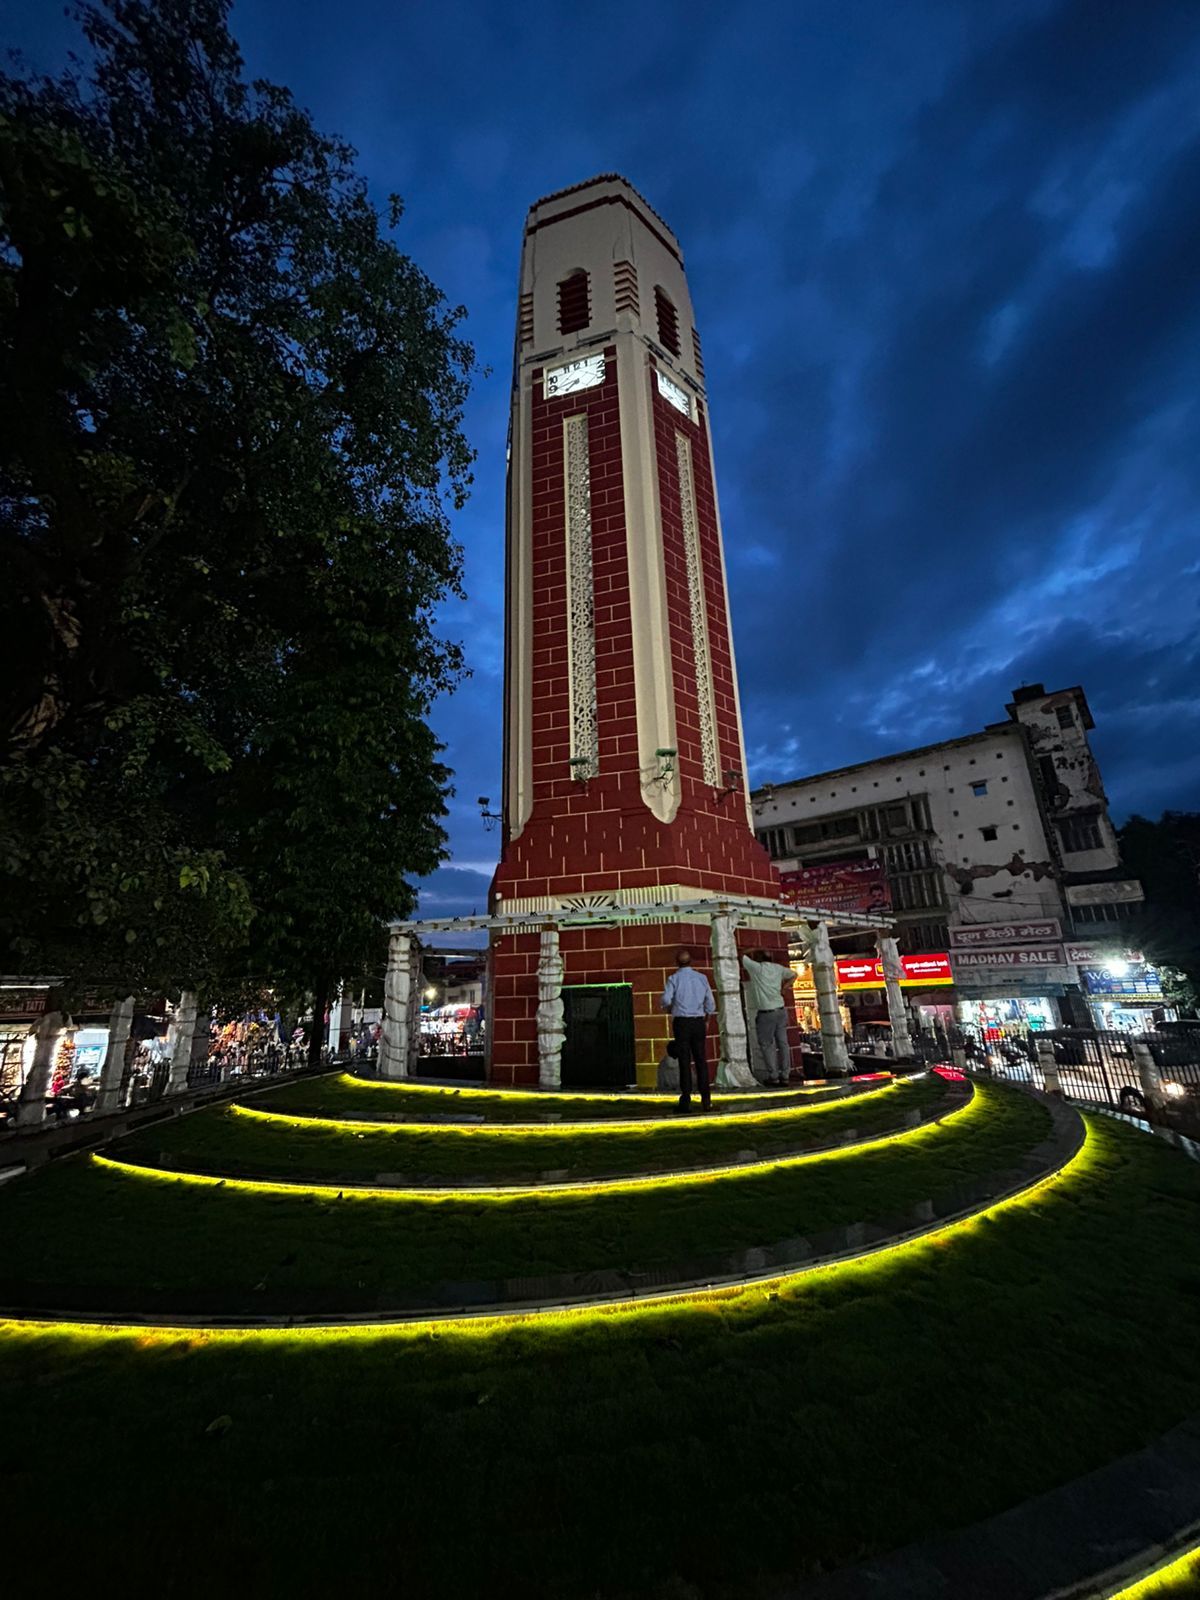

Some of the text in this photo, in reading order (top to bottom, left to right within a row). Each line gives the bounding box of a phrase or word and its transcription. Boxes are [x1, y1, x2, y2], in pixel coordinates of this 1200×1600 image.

[548, 359, 605, 384] 10 2
[573, 362, 581, 371] 12
[548, 370, 605, 394] 9 3
[958, 951, 1057, 965] MADHAV SALE
